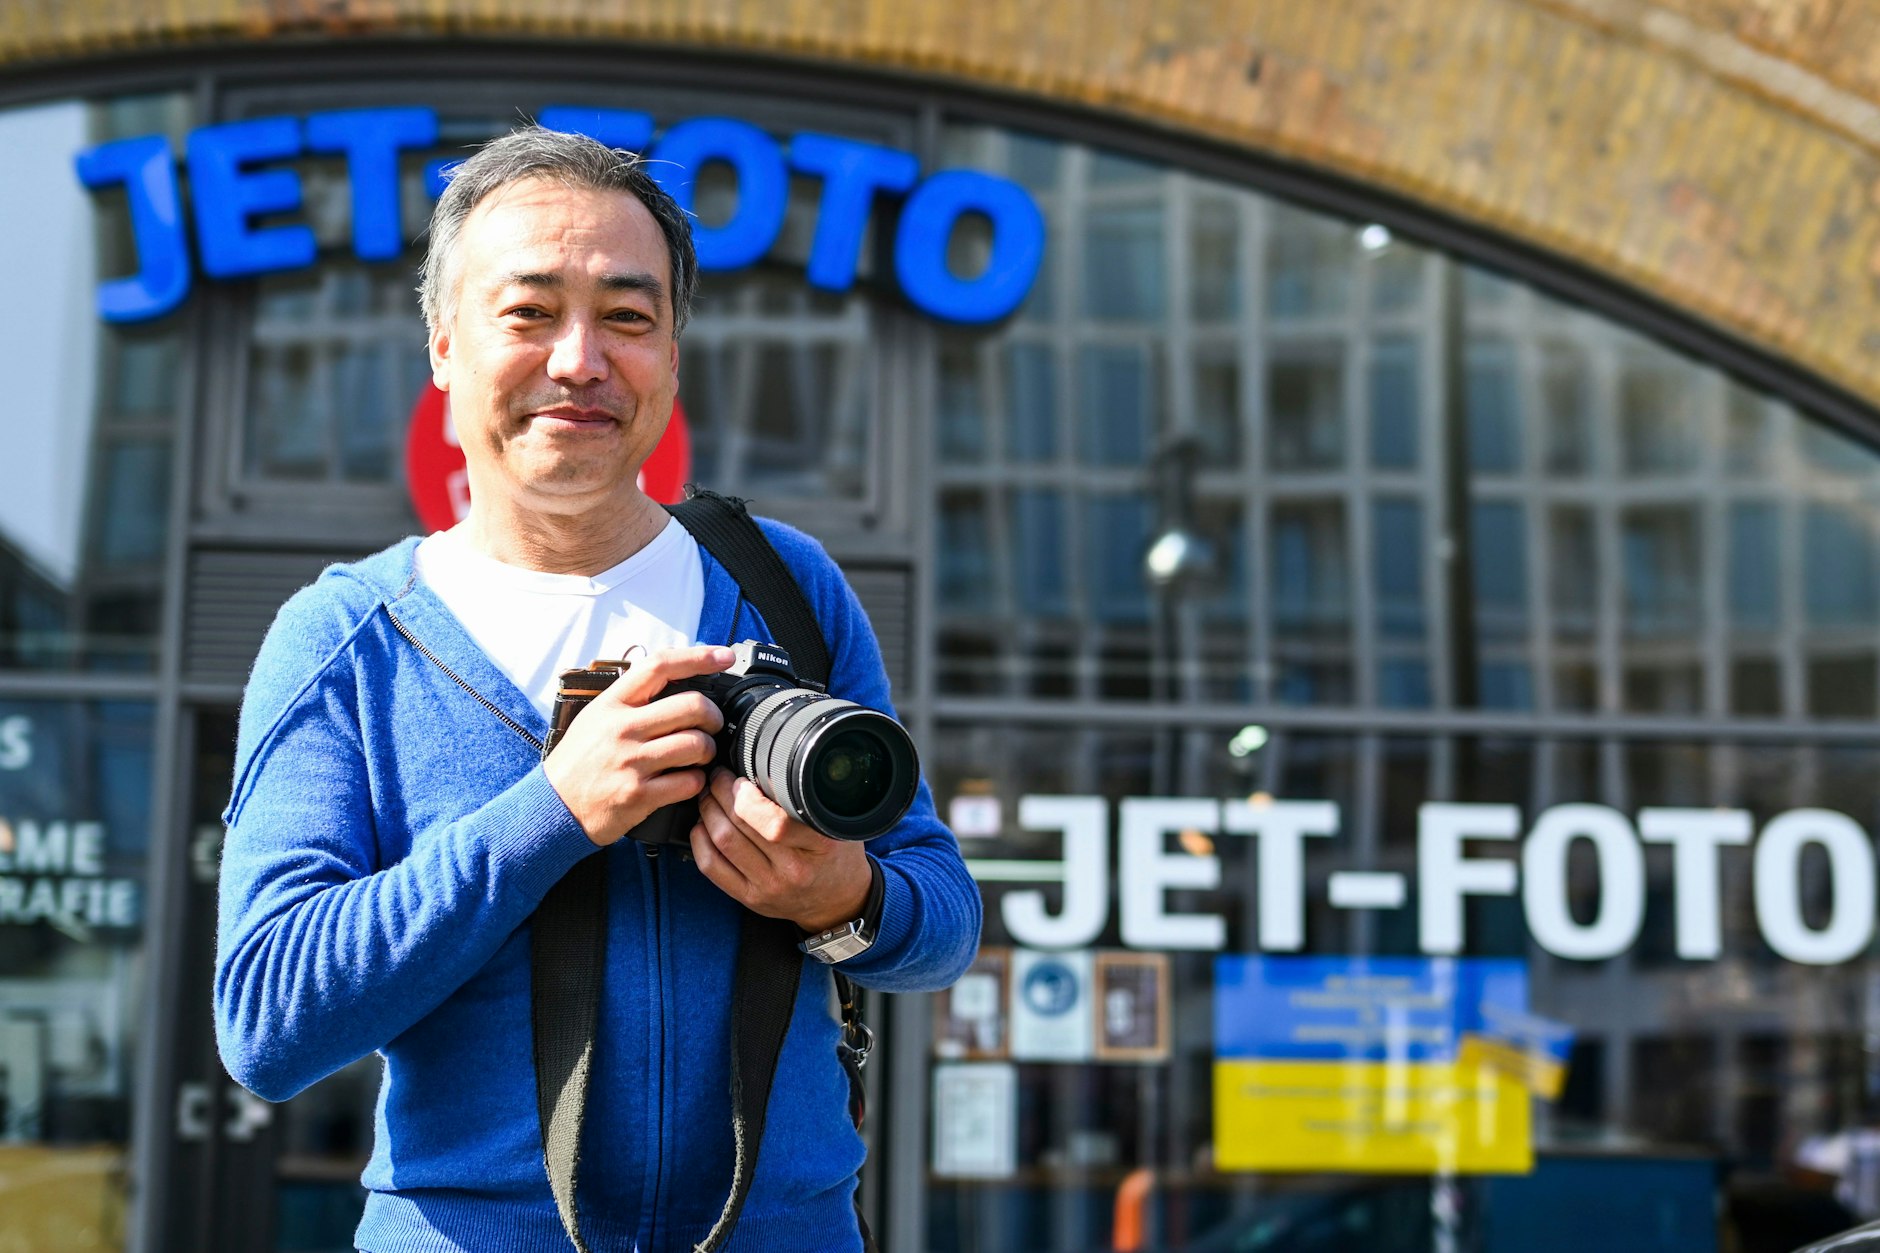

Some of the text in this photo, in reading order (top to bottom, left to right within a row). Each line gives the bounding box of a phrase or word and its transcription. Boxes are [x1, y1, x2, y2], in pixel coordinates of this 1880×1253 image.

[758, 652, 789, 666] Nikon
[0, 820, 103, 875] ME
[1003, 795, 1873, 963] JET-FOTO
